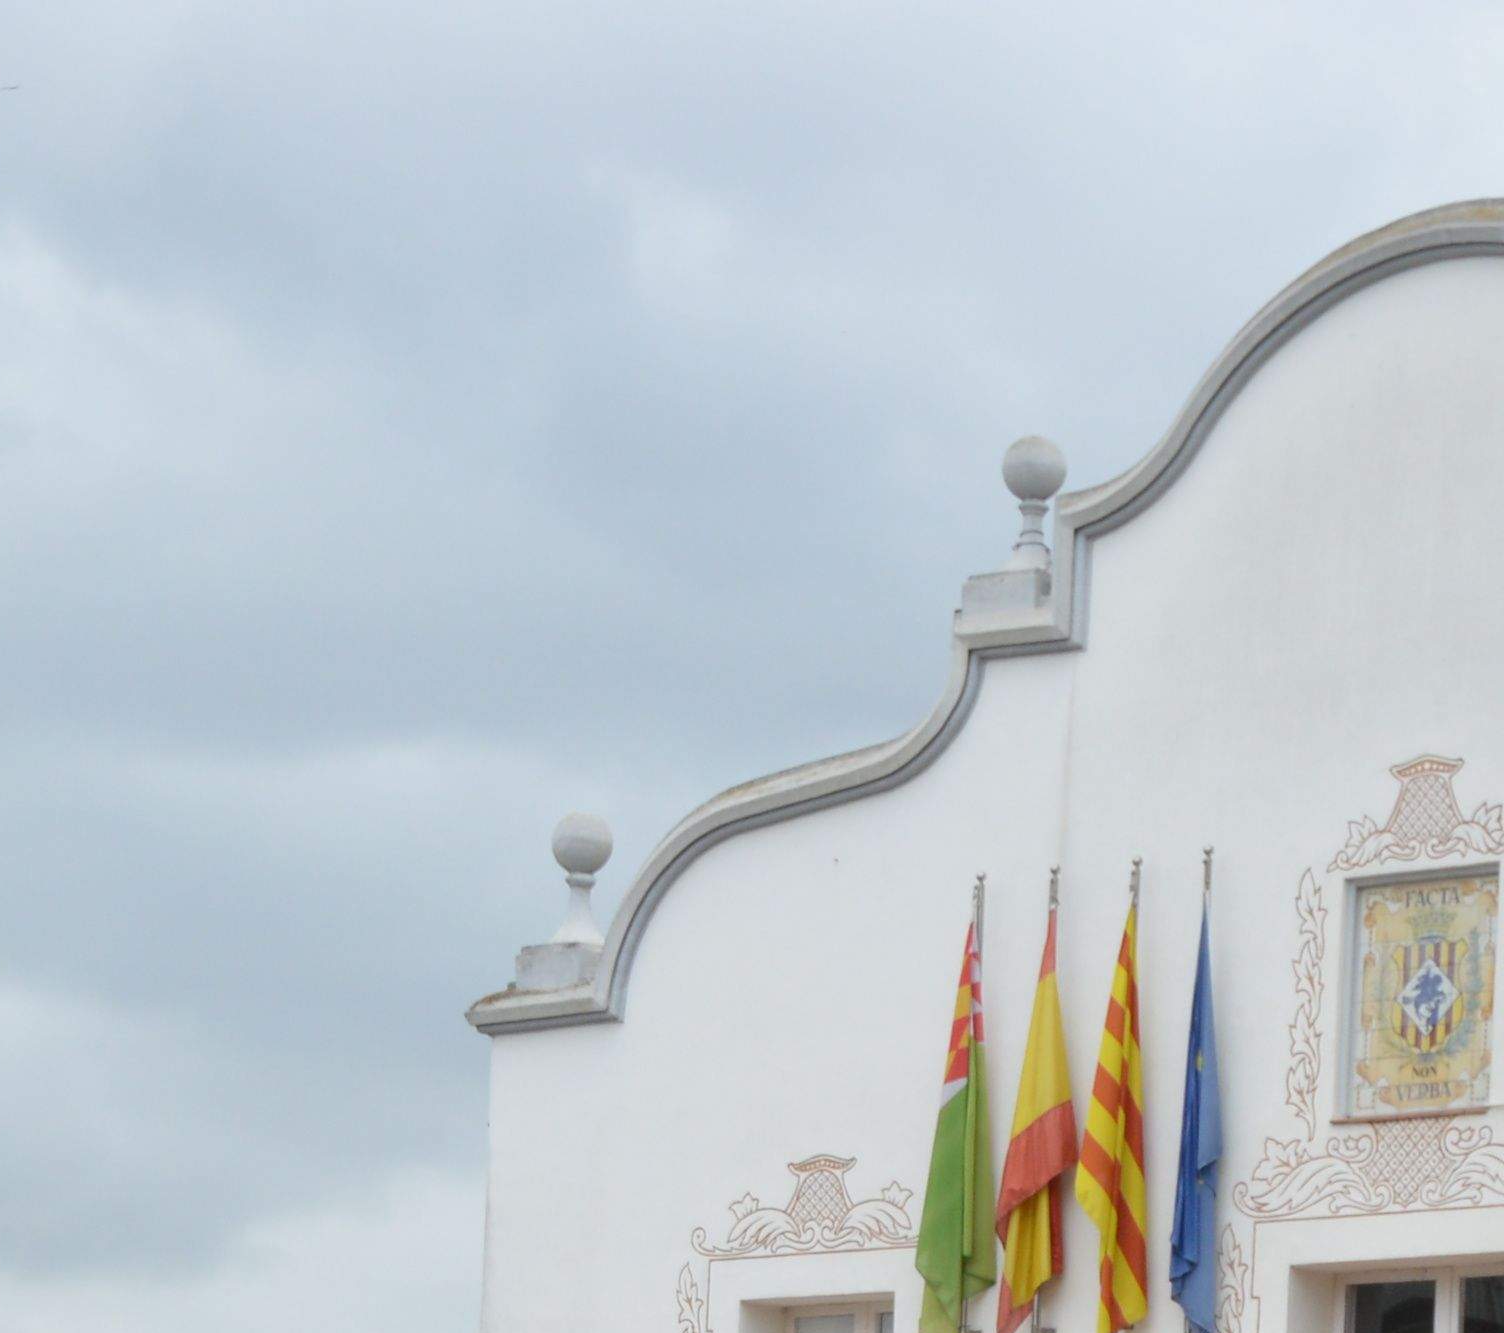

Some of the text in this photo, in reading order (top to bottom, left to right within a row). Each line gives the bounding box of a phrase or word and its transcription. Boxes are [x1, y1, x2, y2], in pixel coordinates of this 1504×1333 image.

[1405, 886, 1461, 908] FACTA
[1411, 1065, 1437, 1078] NON
[1395, 1082, 1453, 1101] VERBA
